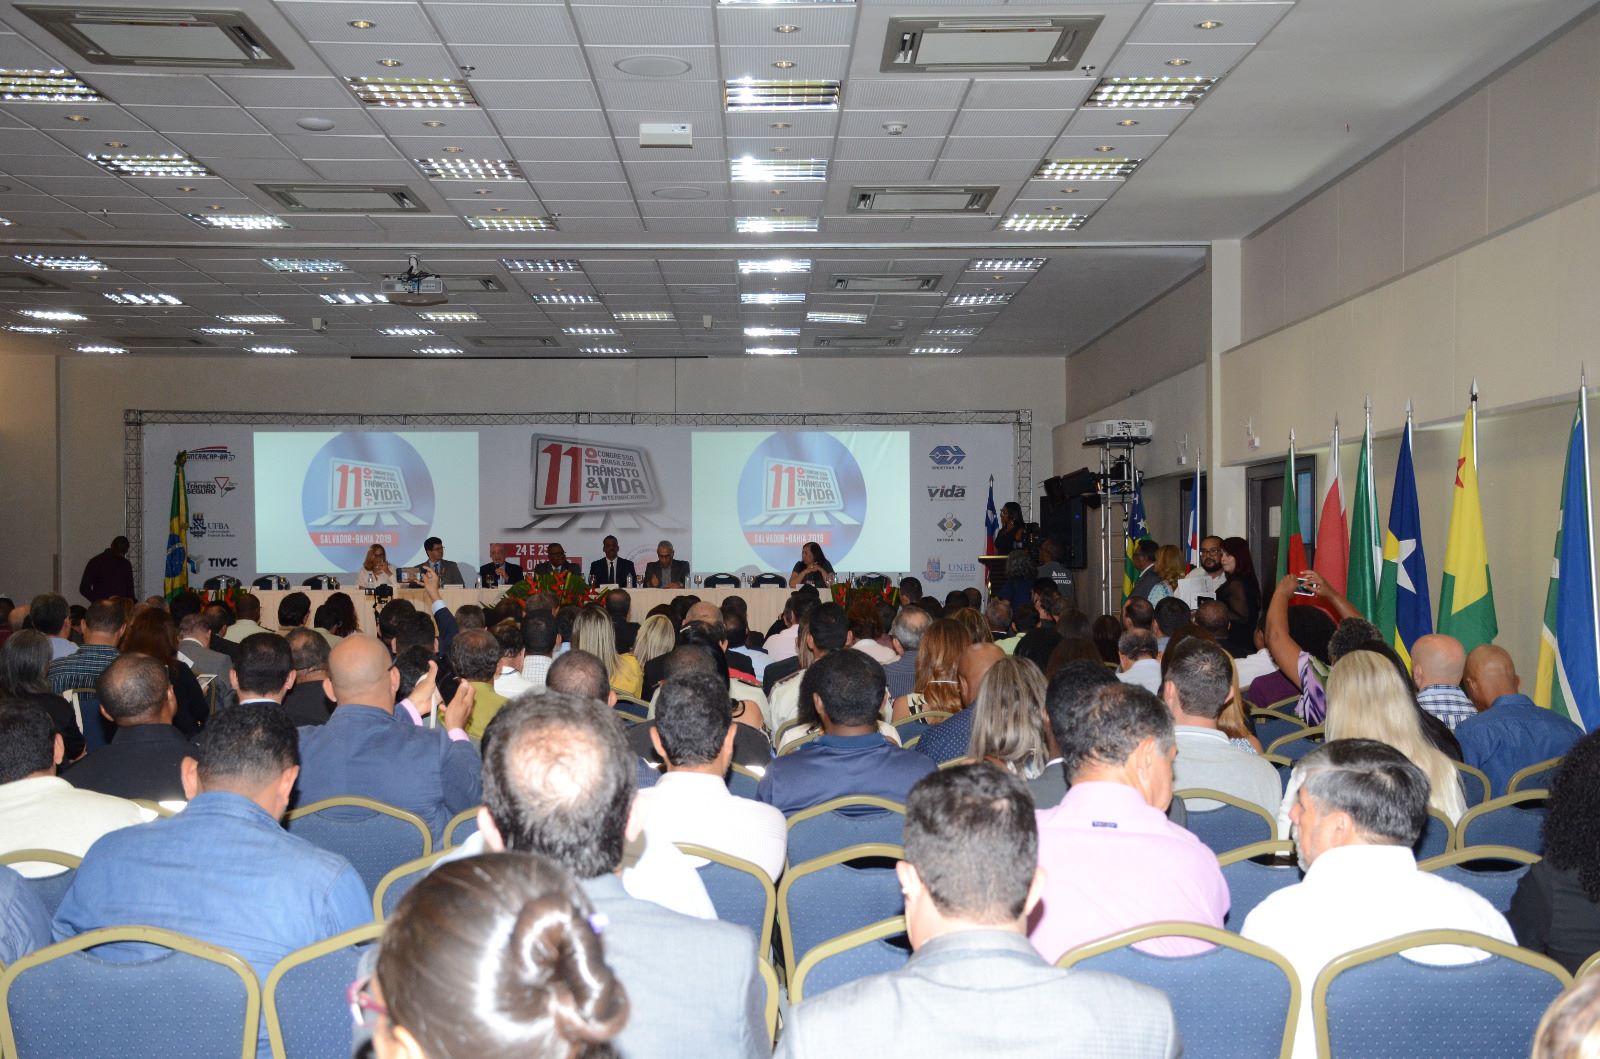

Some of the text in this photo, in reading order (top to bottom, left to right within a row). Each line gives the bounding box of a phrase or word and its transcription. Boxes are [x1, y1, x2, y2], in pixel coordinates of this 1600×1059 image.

[597, 449, 635, 461] CONGRESSO
[600, 458, 637, 467] BRASILEIRO
[585, 465, 640, 478] TRÂNSITO
[927, 485, 966, 498] vida
[375, 534, 392, 544] 2019
[515, 544, 527, 556] 24
[529, 544, 535, 556] E
[208, 558, 239, 568] TIVIC
[948, 563, 976, 572] UNEB
